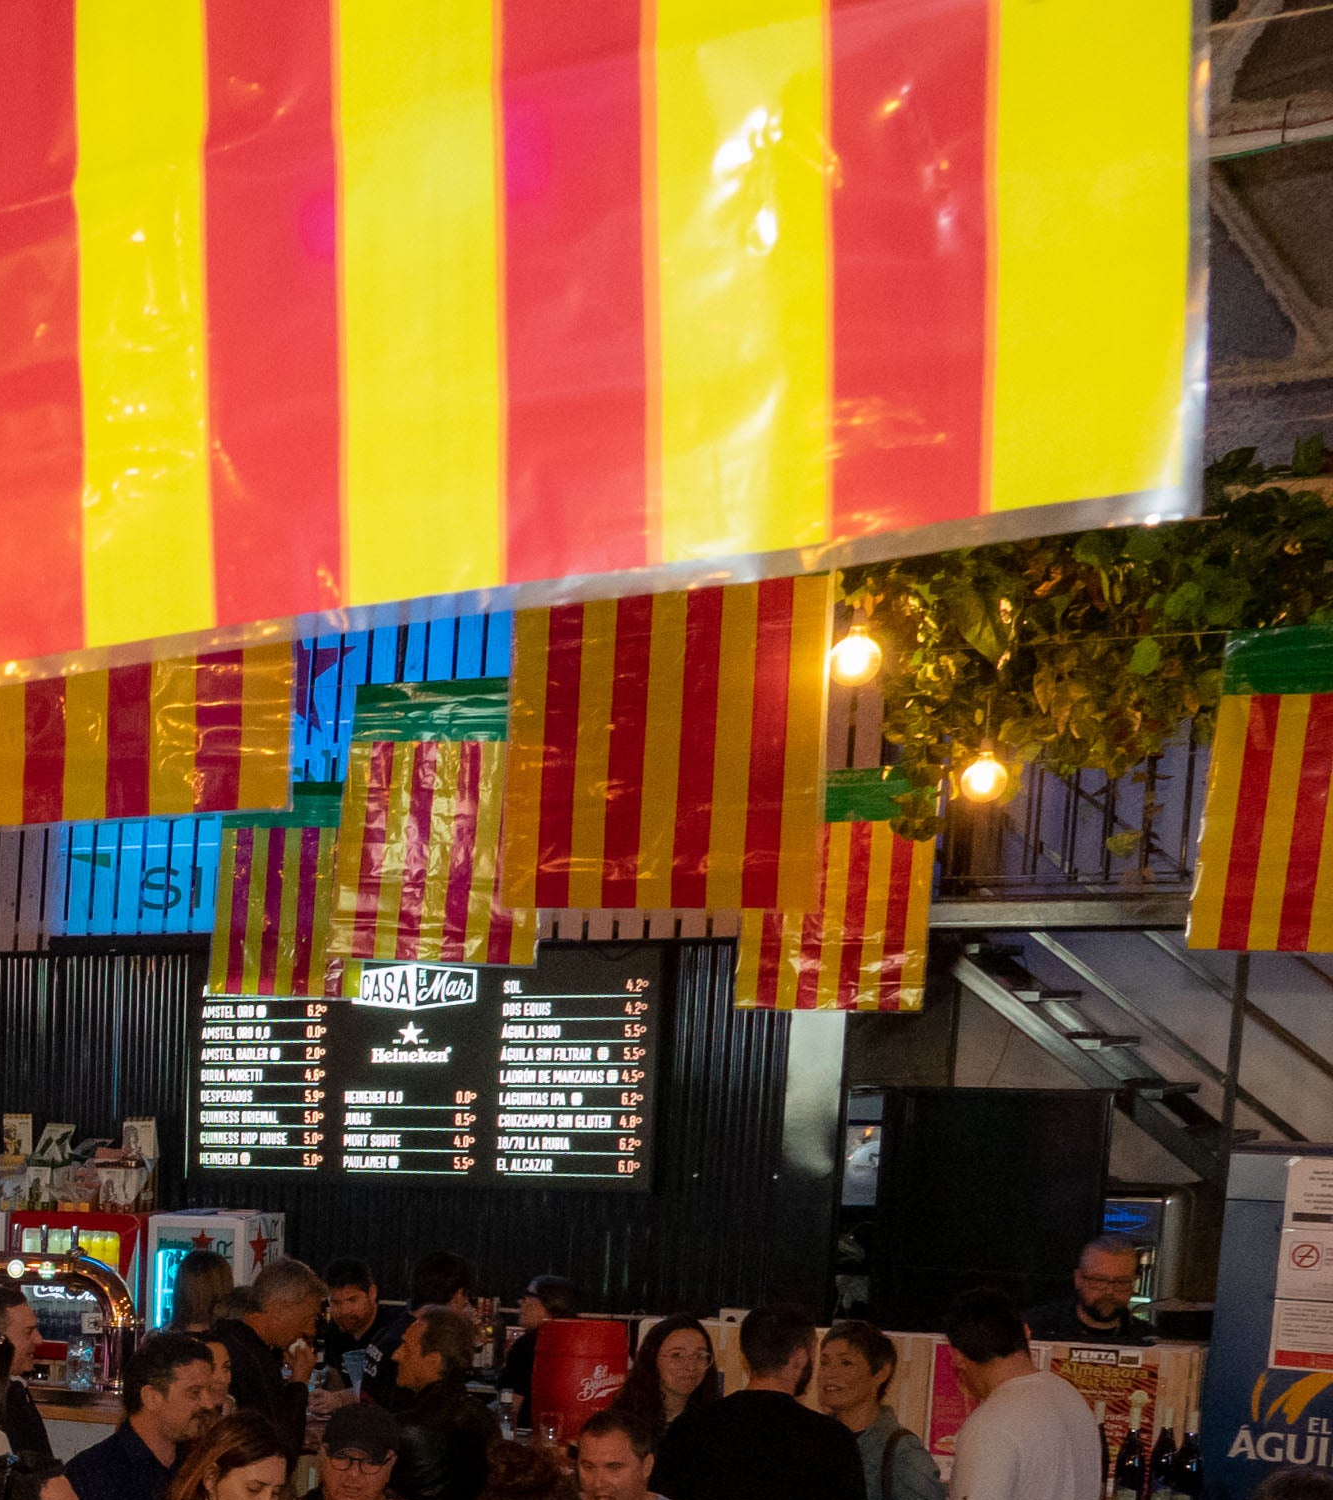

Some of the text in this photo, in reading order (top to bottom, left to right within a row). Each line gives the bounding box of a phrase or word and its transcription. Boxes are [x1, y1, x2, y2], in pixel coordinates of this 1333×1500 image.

[142, 866, 217, 910] SI
[363, 970, 410, 1005] CASA
[417, 971, 471, 1003] Mar
[503, 980, 523, 994] SOL
[202, 1005, 255, 1018] AMSTEL ORO
[502, 1003, 551, 1016] DOS EQUIS
[201, 1026, 235, 1039] AMSTEL
[236, 1026, 254, 1039] ORO
[501, 1024, 535, 1039] ÁGUILA
[201, 1048, 268, 1060] AMSTEL RADLER
[371, 1047, 450, 1063] Heineken
[500, 1046, 592, 1061] ÁGUILA SIN FILTRAR
[200, 1069, 263, 1081] BIRRA MORETTI
[499, 1069, 605, 1084] LADRÓN DE MANZANAS
[200, 1090, 253, 1102] DESPERADOS
[344, 1091, 386, 1104] HEINEKEN
[498, 1092, 566, 1106] LAGUNITAS IPA
[199, 1111, 279, 1124] GUINNESS ORIGINAL
[343, 1113, 372, 1126] JUDAS
[497, 1114, 612, 1128] CRUZCAMPO SIN GLUTEN
[199, 1132, 288, 1144] GUINNESS HOP HOUSE
[343, 1134, 401, 1147] MORT SUBITE
[527, 1137, 540, 1150] LA
[541, 1137, 570, 1150] RUBIA
[199, 1153, 238, 1165] HEINEKEN
[342, 1156, 387, 1169] PAULANER
[496, 1158, 553, 1171] EL ALCAZAR
[1060, 1362, 1148, 1379] Almassora
[1307, 1417, 1332, 1435] EL
[1227, 1424, 1333, 1468] ÁGUI
